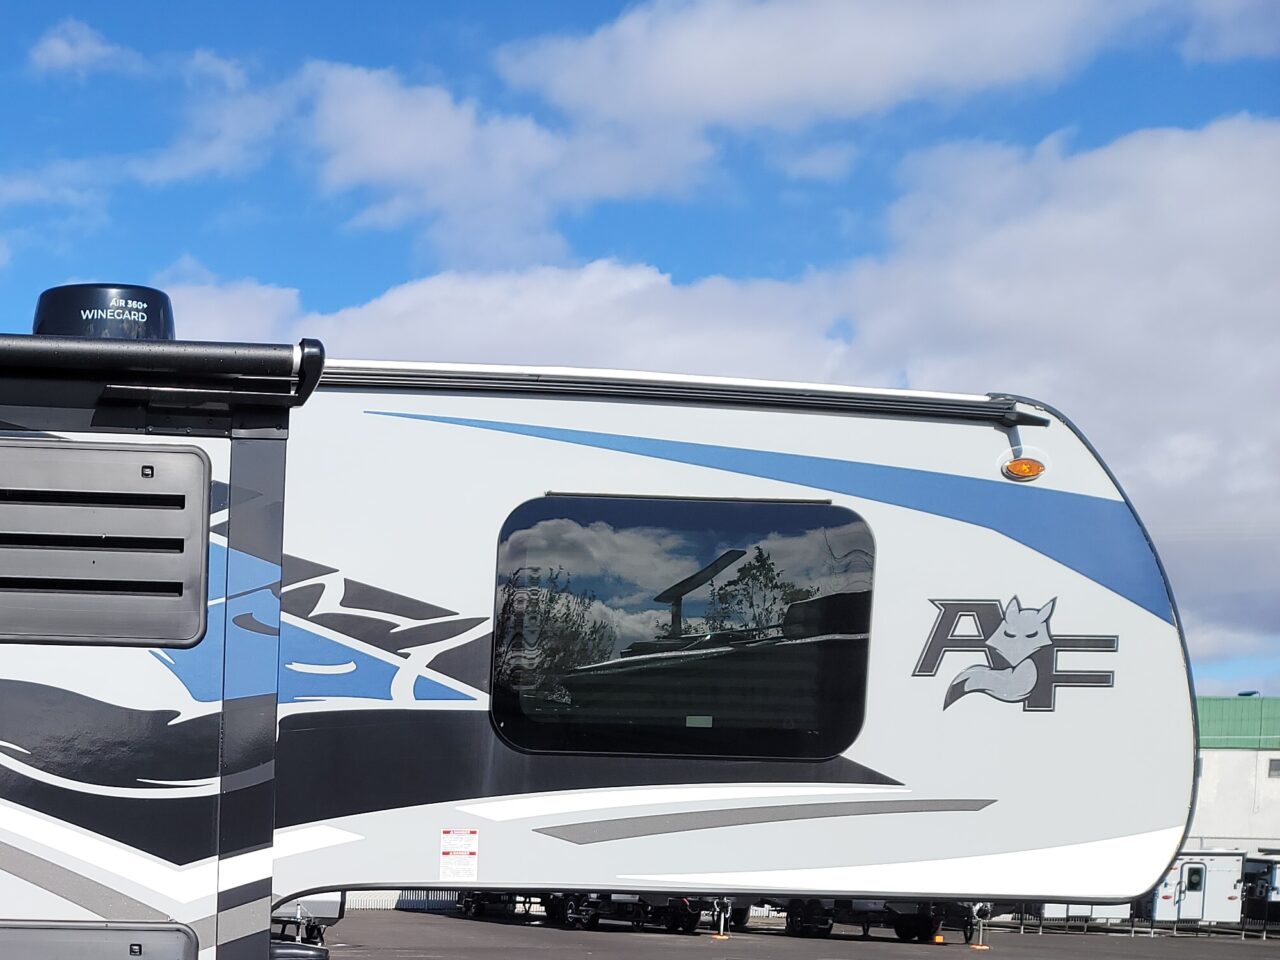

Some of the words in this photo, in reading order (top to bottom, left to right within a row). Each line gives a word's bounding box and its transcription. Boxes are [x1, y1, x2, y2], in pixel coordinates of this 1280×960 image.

[110, 298, 126, 308] AIR
[127, 299, 148, 310] 360+
[80, 309, 148, 323] WINEGARD
